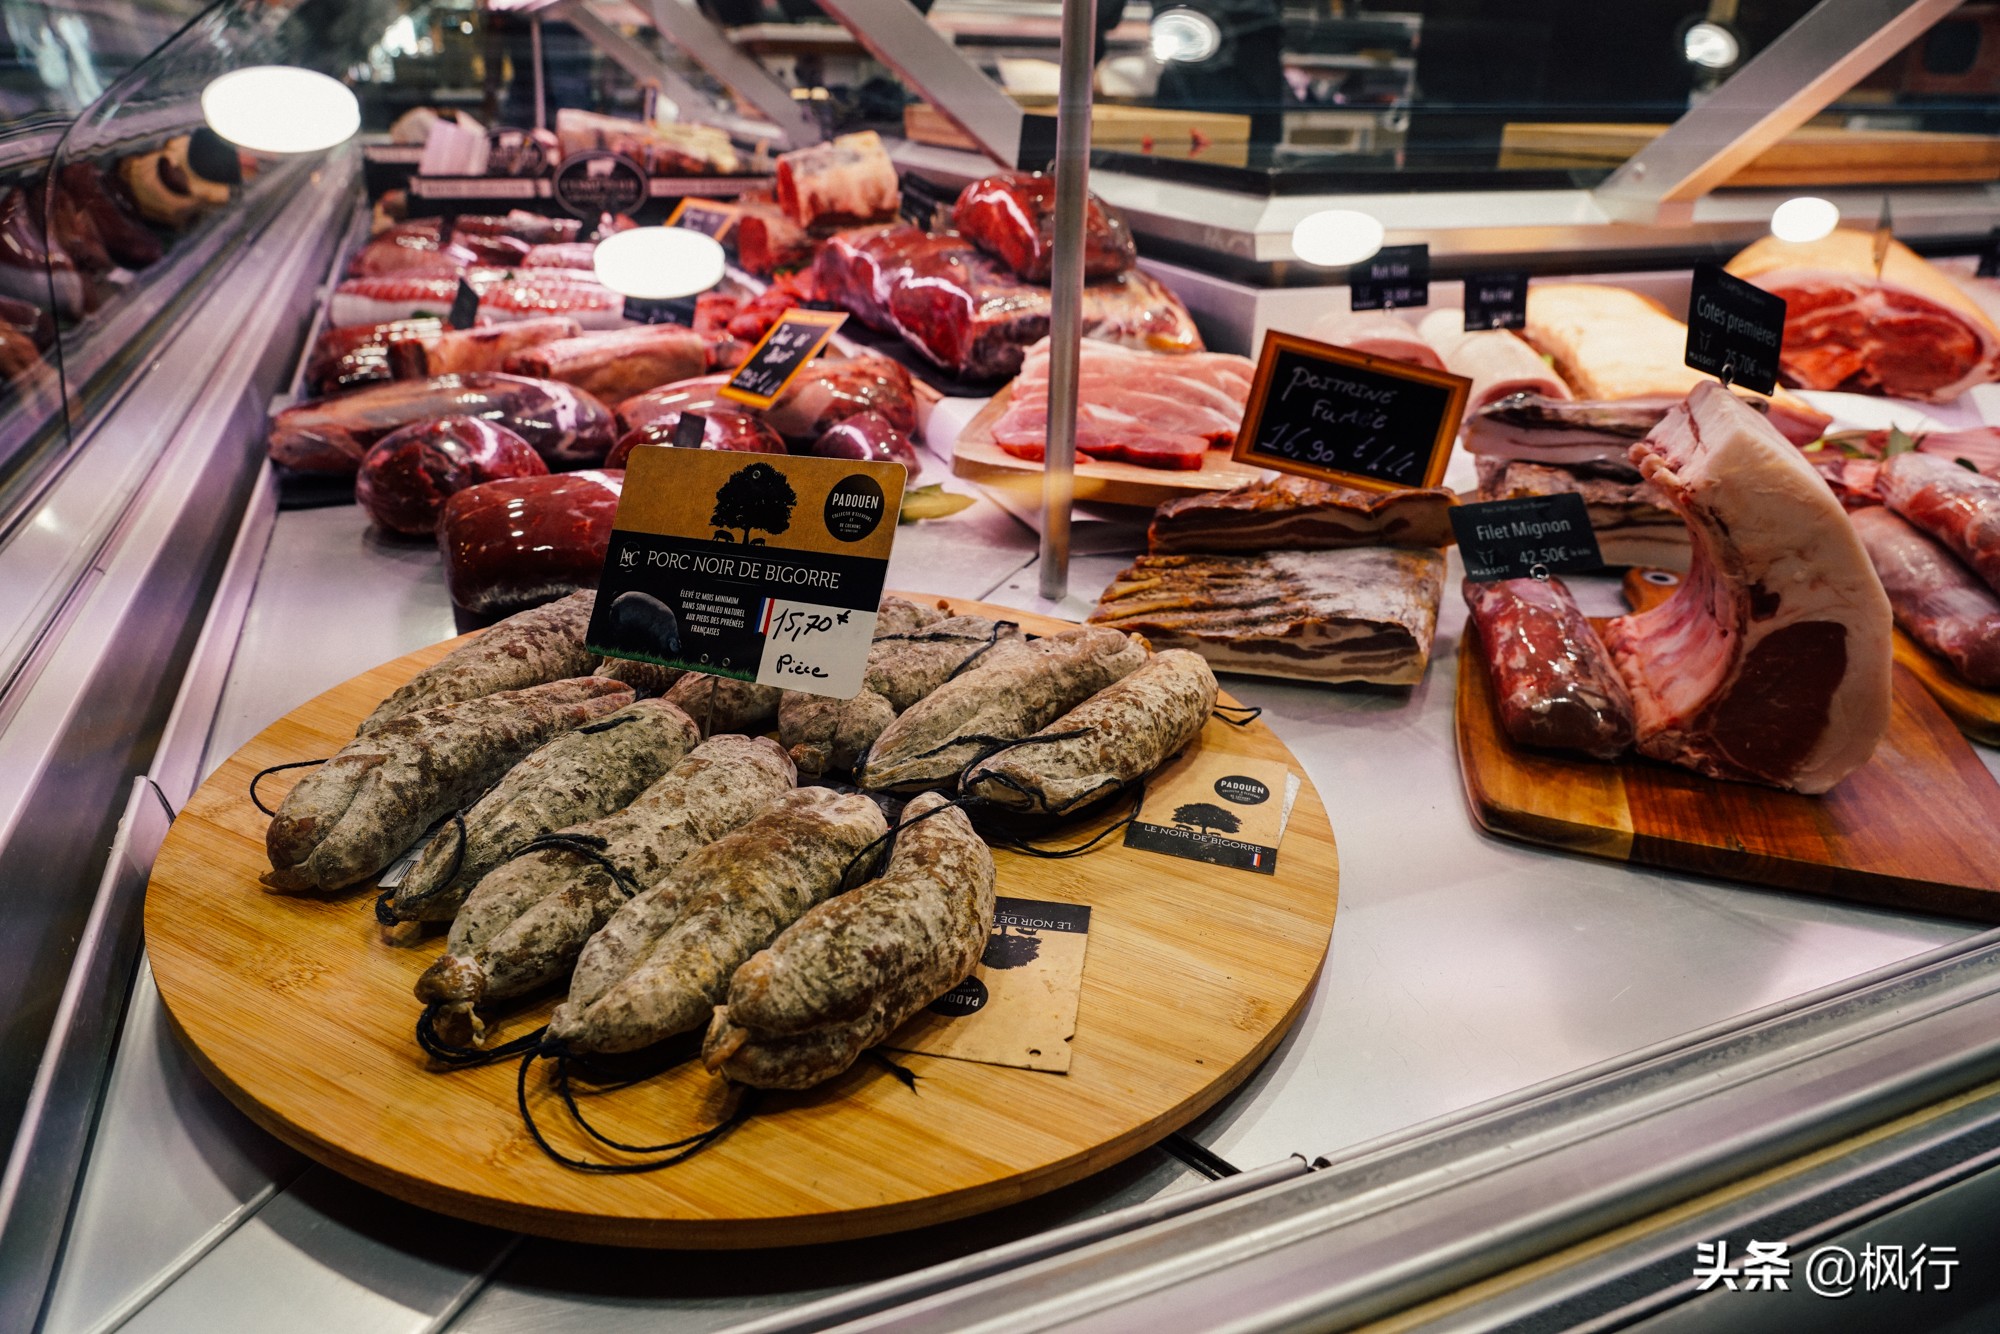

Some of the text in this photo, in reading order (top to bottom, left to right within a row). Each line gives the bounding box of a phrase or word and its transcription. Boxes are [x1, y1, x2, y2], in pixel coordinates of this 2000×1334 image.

[832, 492, 880, 509] PADOUEN
[1476, 518, 1571, 541] Filet Mignon
[647, 550, 841, 590] PORC NOIR DE BIGORRE
[695, 592, 701, 600] 12
[701, 592, 715, 601] MOIS
[714, 594, 740, 605] MINIMUM
[682, 601, 745, 618] DANS SON MILIEU NATUREL
[685, 612, 745, 629] AUX PIEDS DES PYRÉNÉES
[690, 624, 721, 636] FRANÇAISES
[1220, 780, 1265, 795] PADOUEN
[1144, 824, 1263, 854] LE NOIR DE BIGORRE
[1000, 914, 1018, 927] DE
[1021, 916, 1054, 930] NOIR
[1057, 920, 1072, 931] LE
